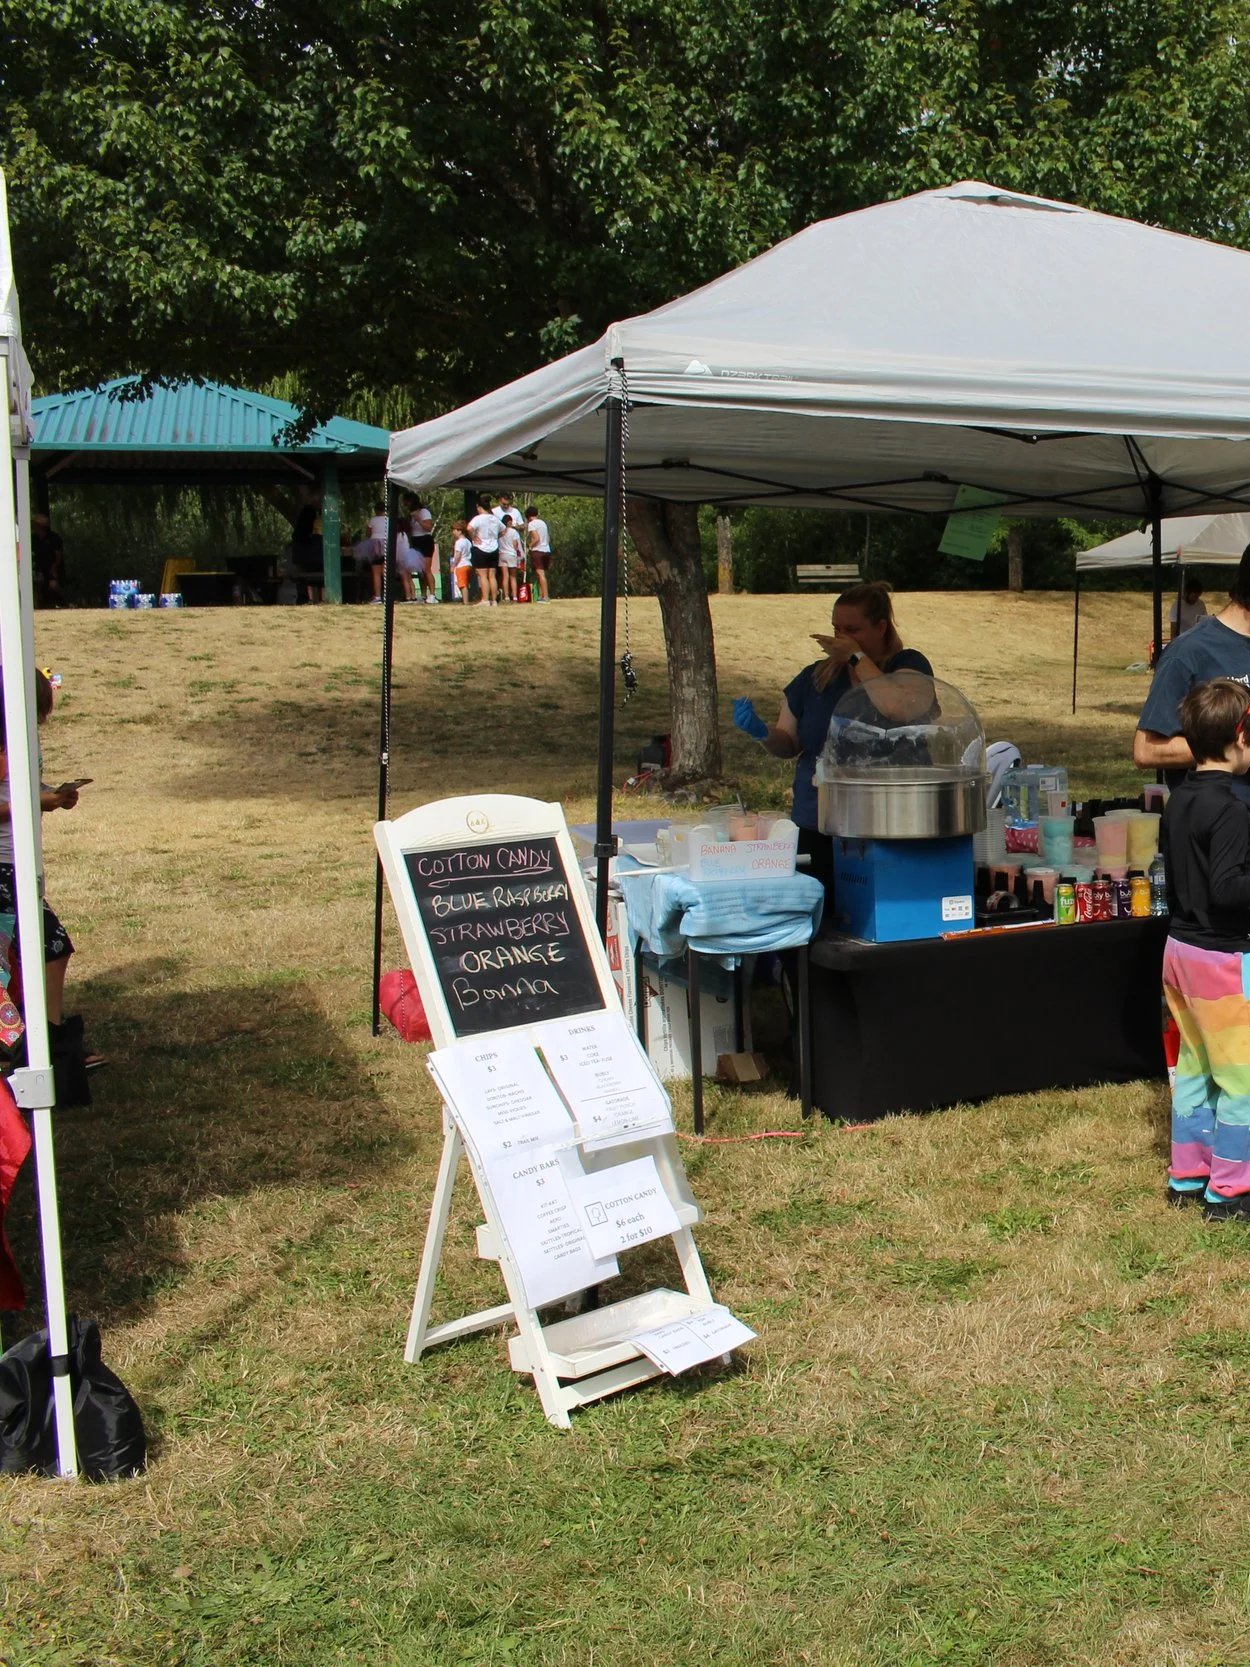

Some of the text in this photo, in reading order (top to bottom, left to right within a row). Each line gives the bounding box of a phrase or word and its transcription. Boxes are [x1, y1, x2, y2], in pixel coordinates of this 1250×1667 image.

[701, 844, 736, 856] BANANA
[418, 847, 552, 876] COTTON CANDY
[752, 859, 790, 870] ORANGE
[431, 890, 490, 917] BLUE
[430, 910, 570, 945] STRAWBERRY
[460, 942, 566, 974] ORANGE
[568, 1025, 596, 1036] DRINKS
[475, 1052, 498, 1063] CHIPS
[560, 1054, 569, 1062] $3
[593, 1115, 602, 1123] $4
[503, 1141, 512, 1149] $2
[512, 1158, 560, 1180] CANDY BARS
[536, 1178, 546, 1187] $3
[604, 1187, 657, 1210] COTTON CANDY
[616, 1212, 645, 1228] $6 each
[548, 1223, 570, 1234] SMARTIES
[620, 1225, 653, 1244] 2 for $10
[553, 1251, 569, 1260] CANDY
